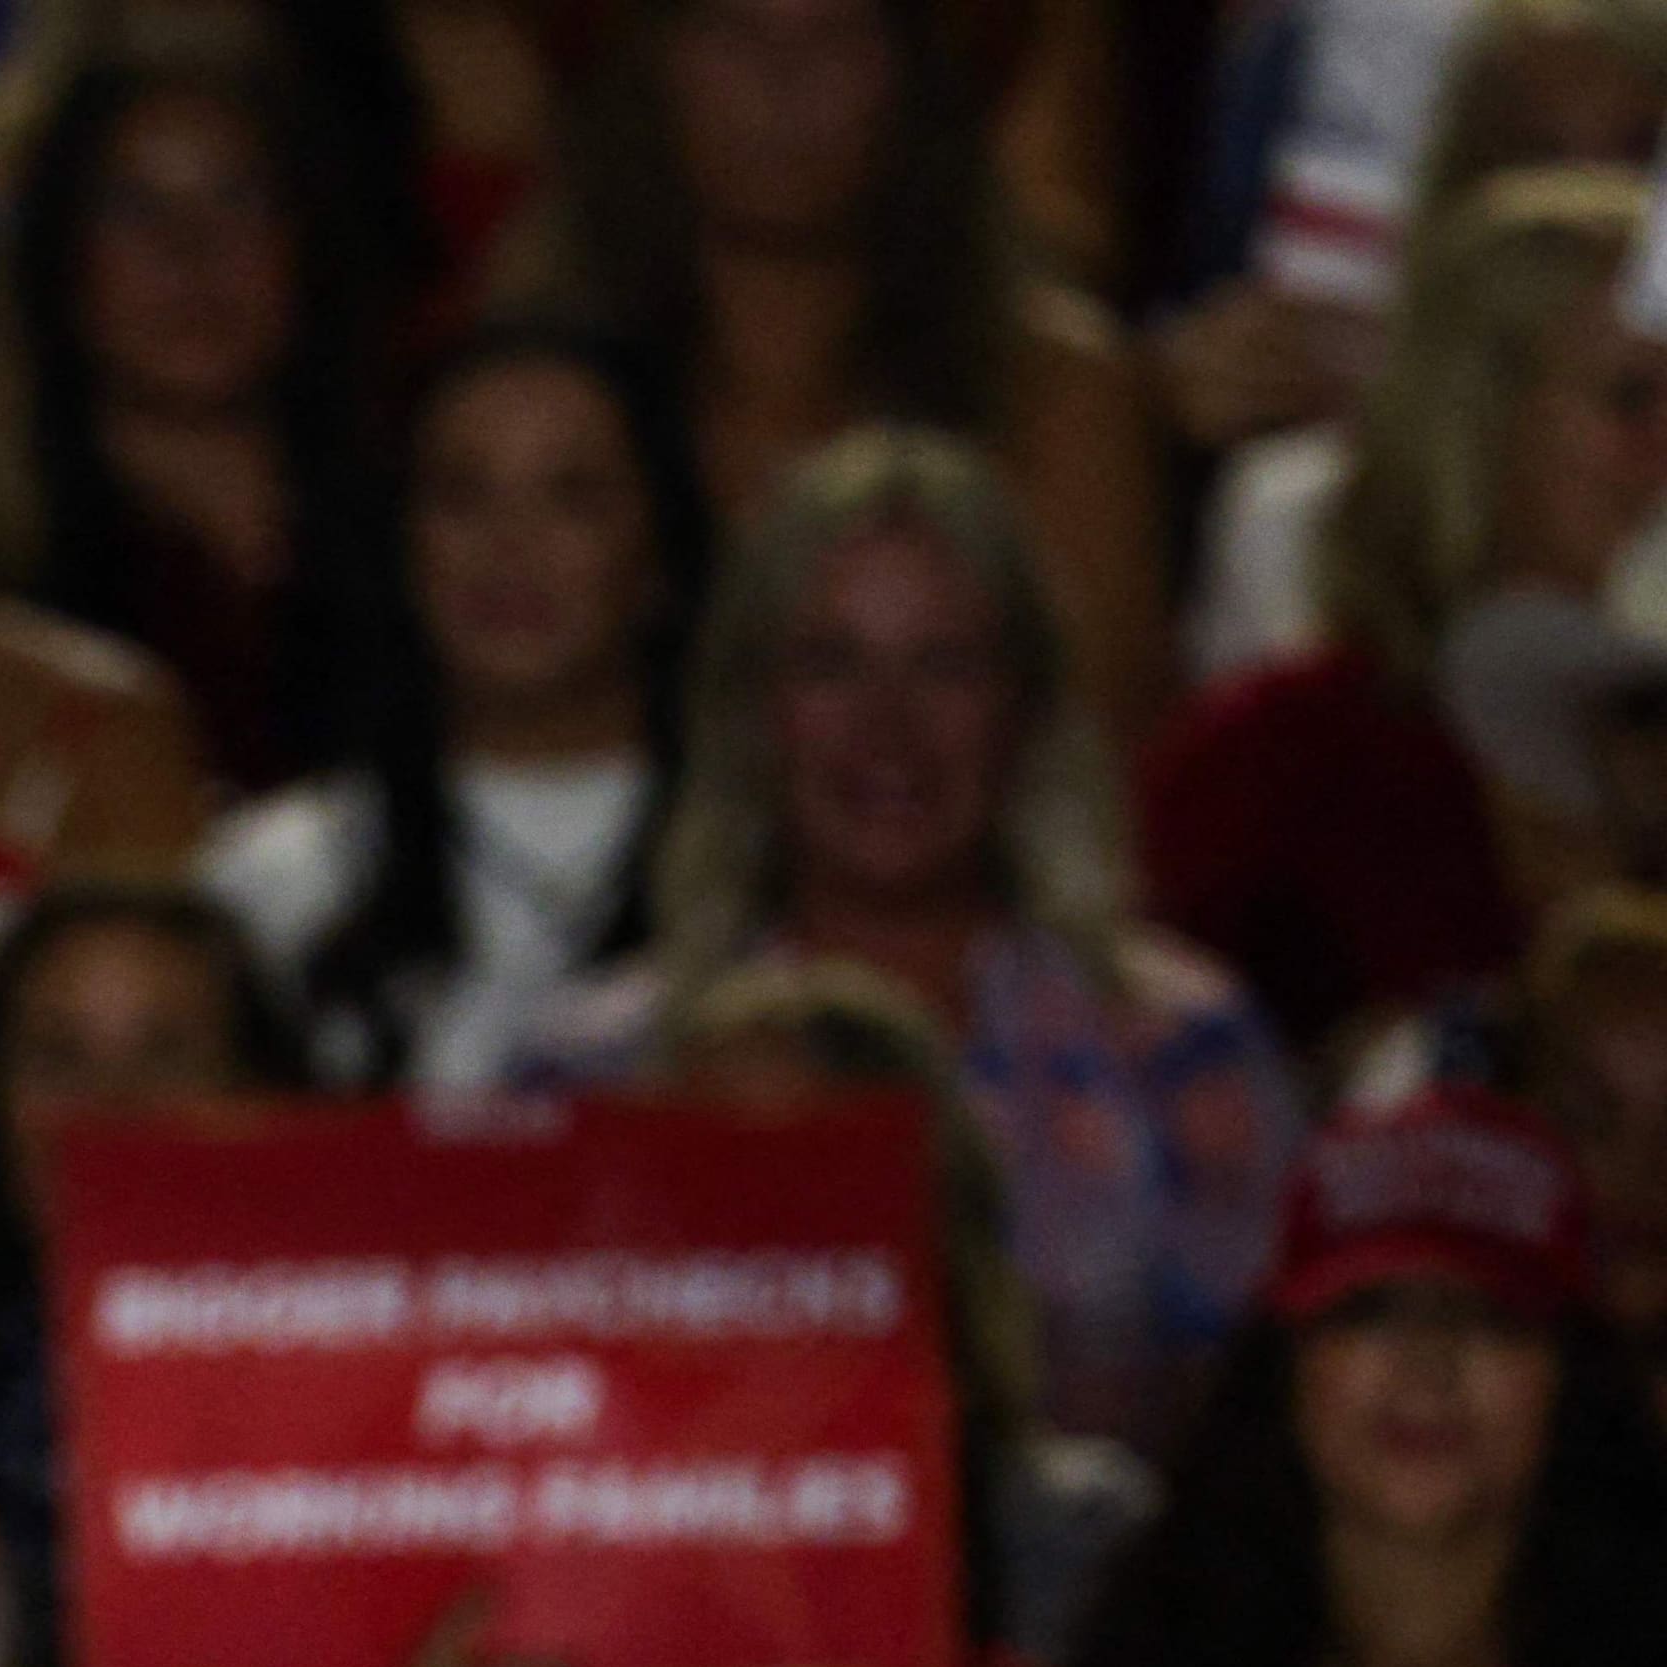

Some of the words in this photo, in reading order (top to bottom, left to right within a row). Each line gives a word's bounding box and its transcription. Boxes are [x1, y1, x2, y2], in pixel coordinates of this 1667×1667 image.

[95, 1262, 409, 1354] BIGGER
[427, 1248, 903, 1340] PAYCHECKS
[417, 1358, 605, 1446] FOR
[117, 1466, 515, 1558] WORKING
[533, 1450, 905, 1544] FAMILIES
